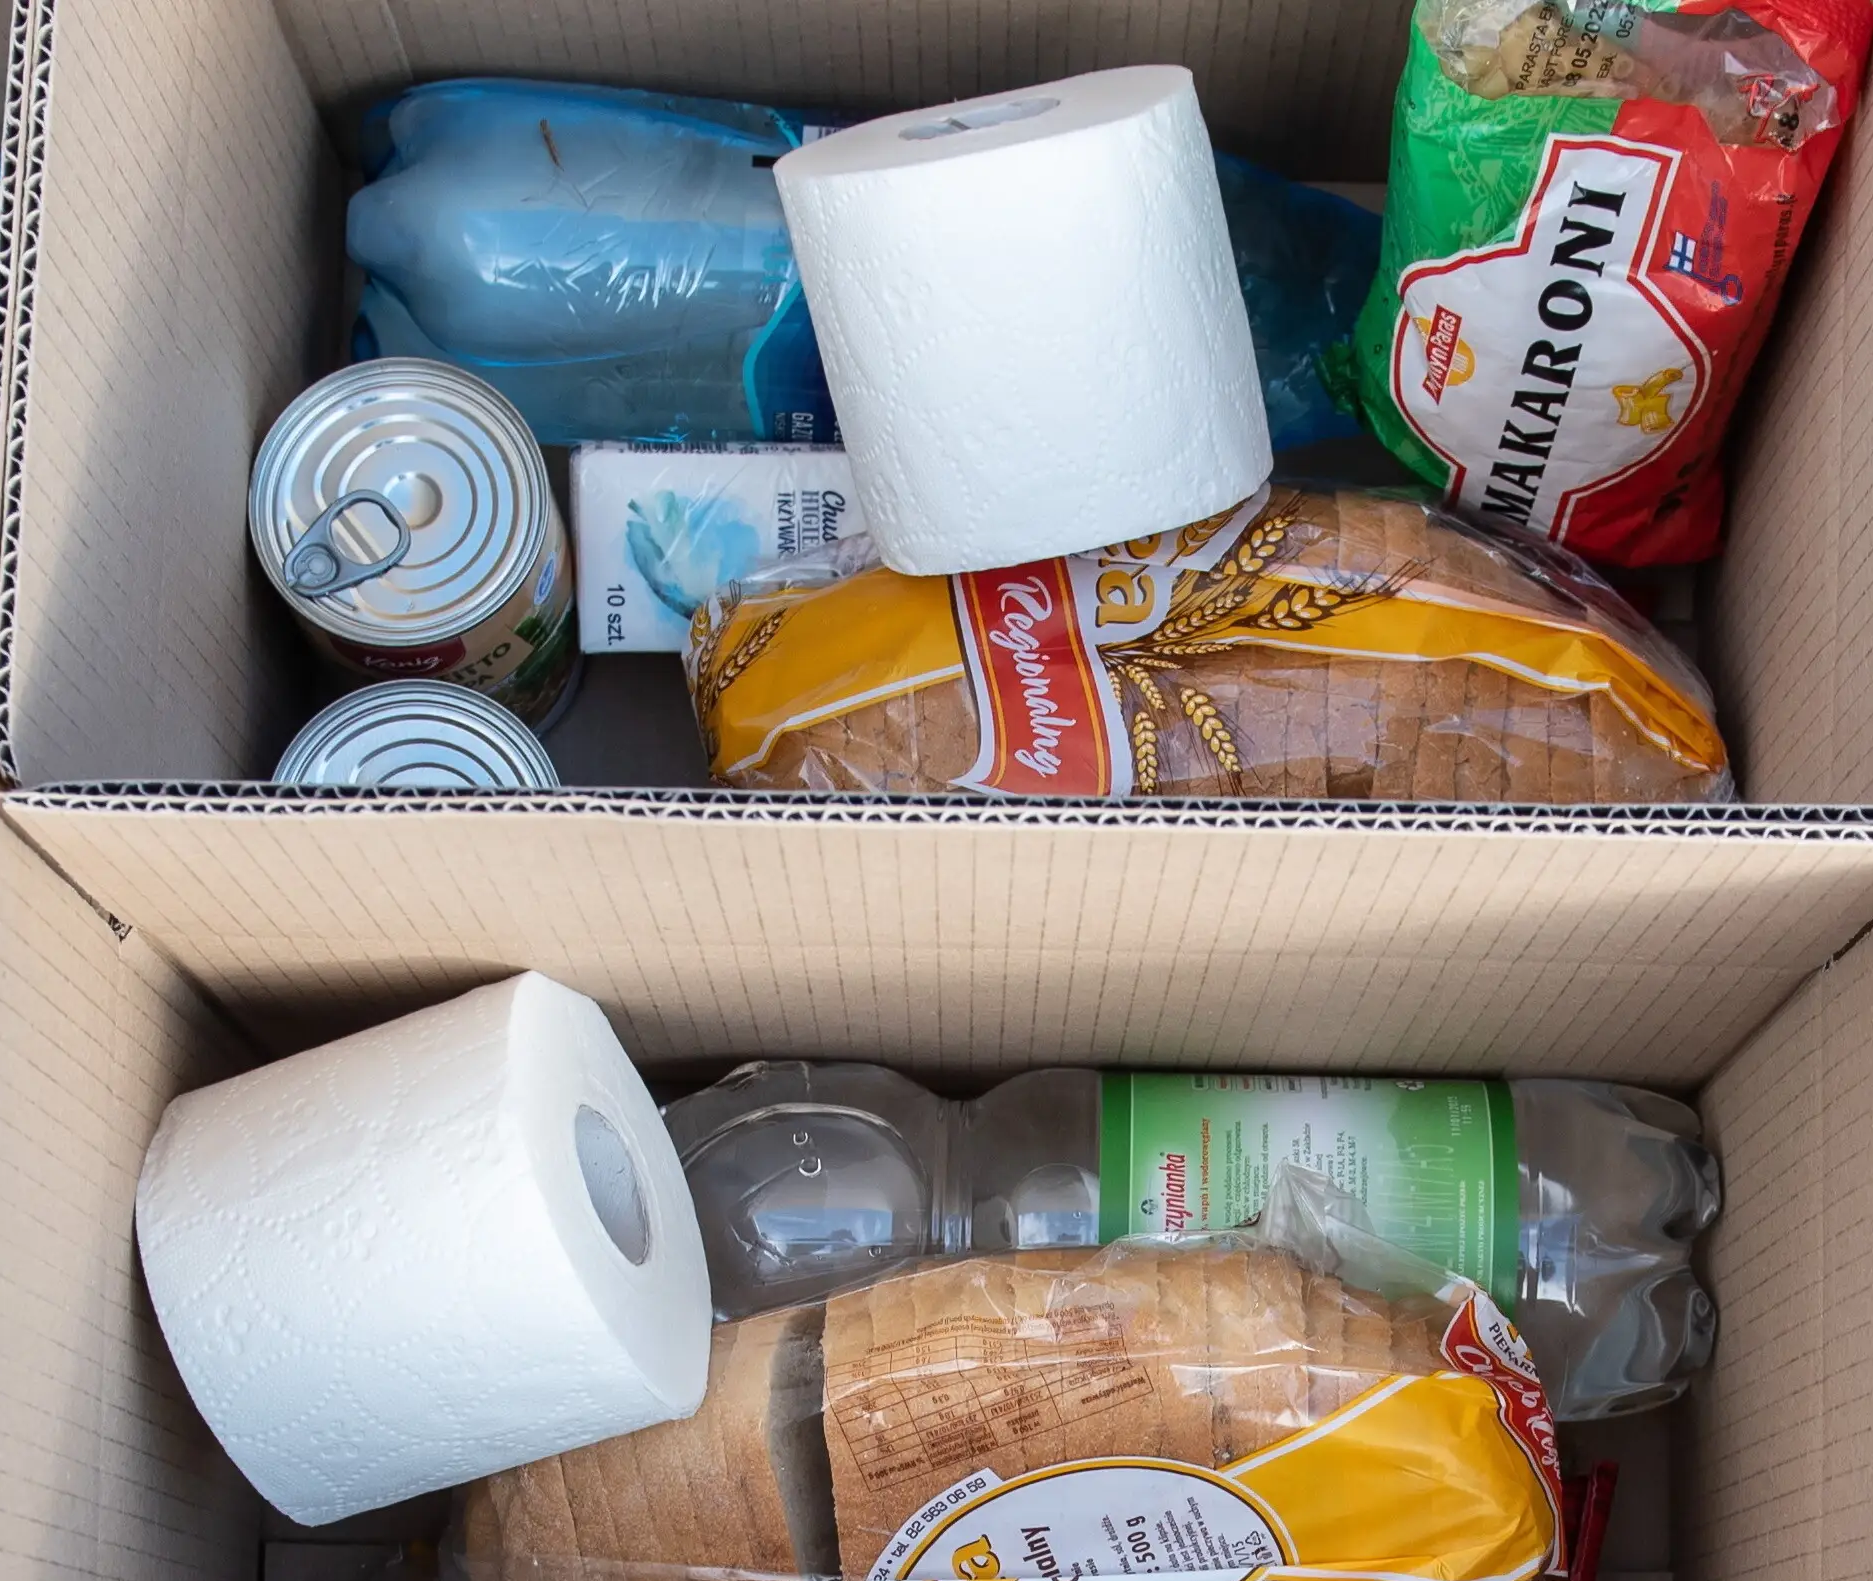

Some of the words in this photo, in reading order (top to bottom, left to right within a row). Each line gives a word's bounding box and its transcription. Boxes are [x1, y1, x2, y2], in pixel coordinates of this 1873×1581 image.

[1480, 180, 1628, 528] MAKARONI
[605, 583, 625, 608] 10
[605, 611, 624, 646] szt.
[988, 573, 1078, 781] Regionalny
[904, 1519, 925, 1541] 82
[921, 1500, 949, 1523] 563
[946, 1488, 967, 1505] 06
[968, 1477, 988, 1493] 59
[1129, 1531, 1157, 1562] 500
